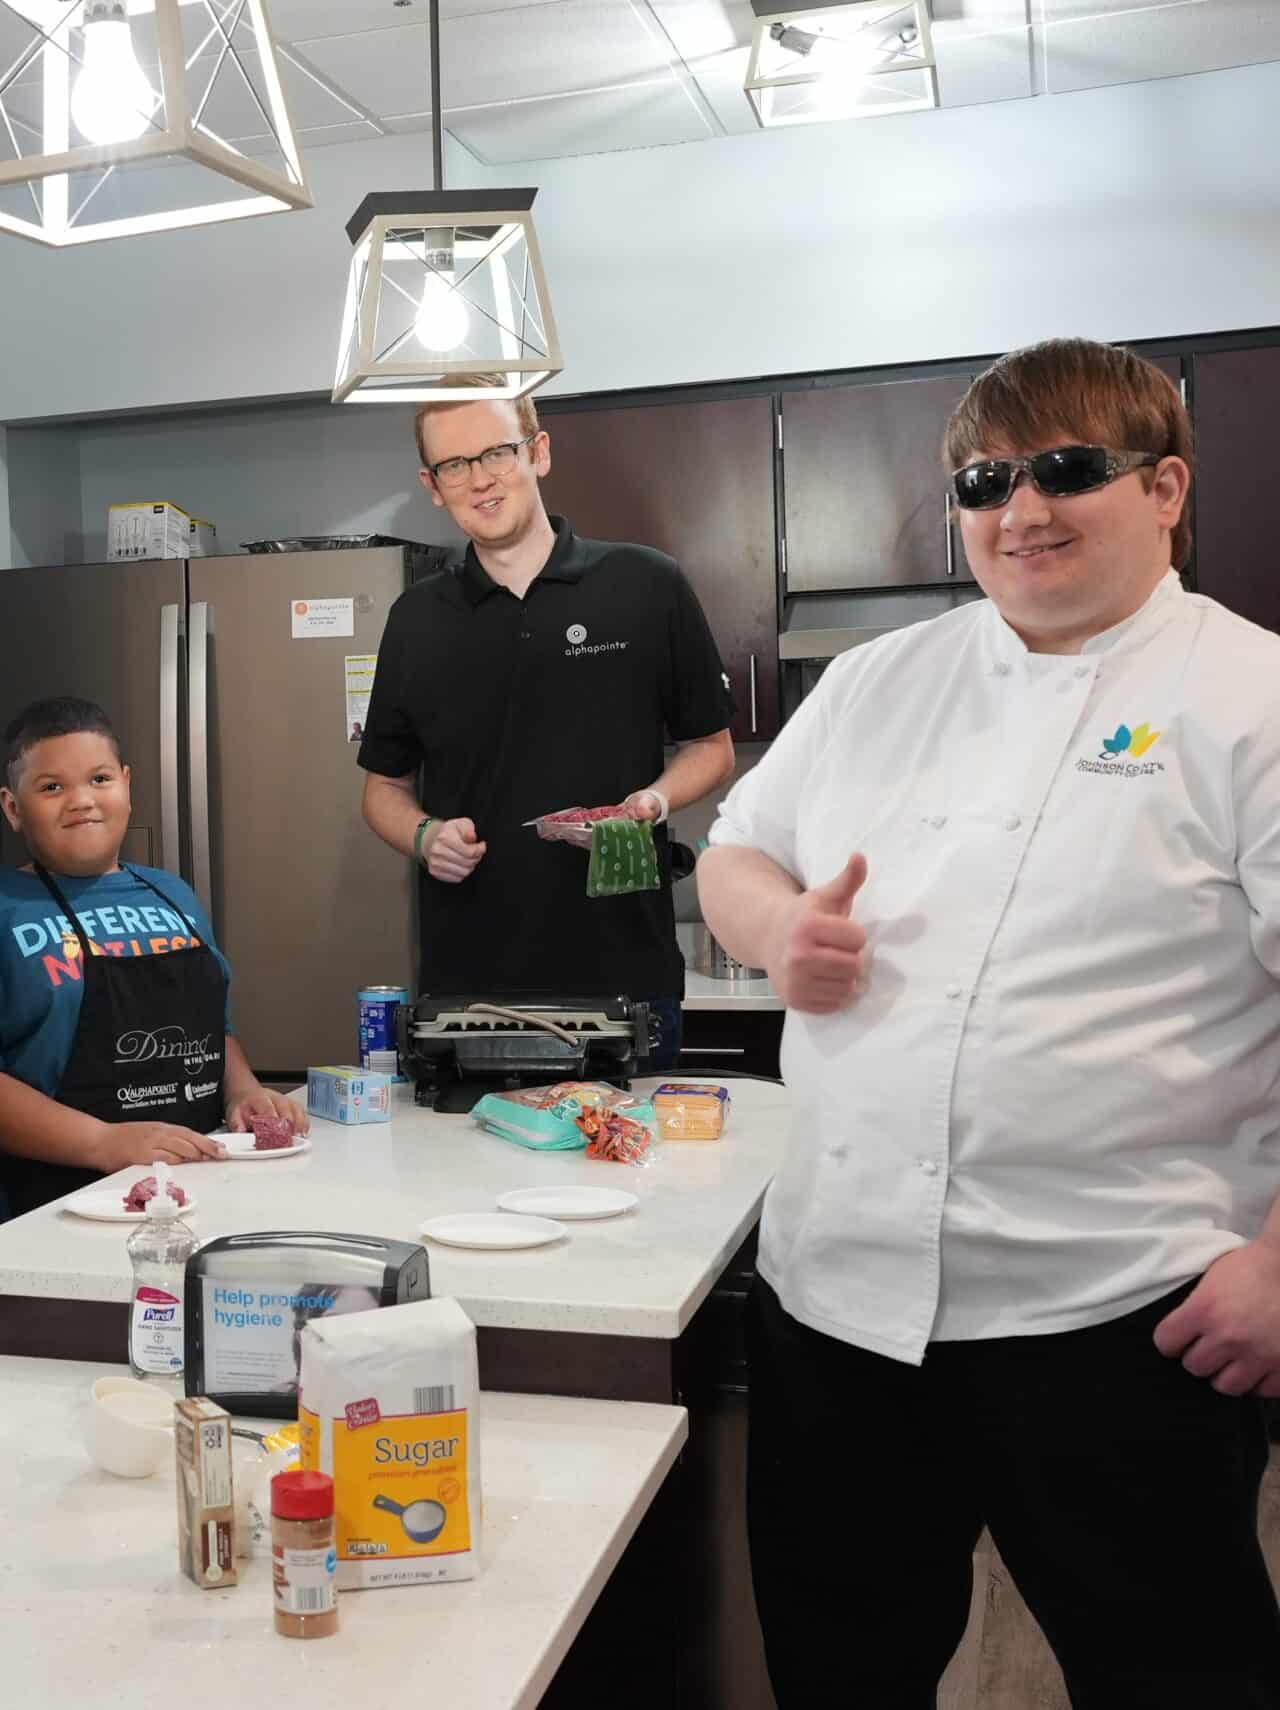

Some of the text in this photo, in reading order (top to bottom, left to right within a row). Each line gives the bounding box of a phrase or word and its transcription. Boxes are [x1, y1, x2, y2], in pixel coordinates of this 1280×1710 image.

[114, 1026, 212, 1075] Dining
[214, 1287, 336, 1311] Help promote
[214, 1308, 284, 1329] hygiene
[375, 1437, 460, 1467] Sugar
